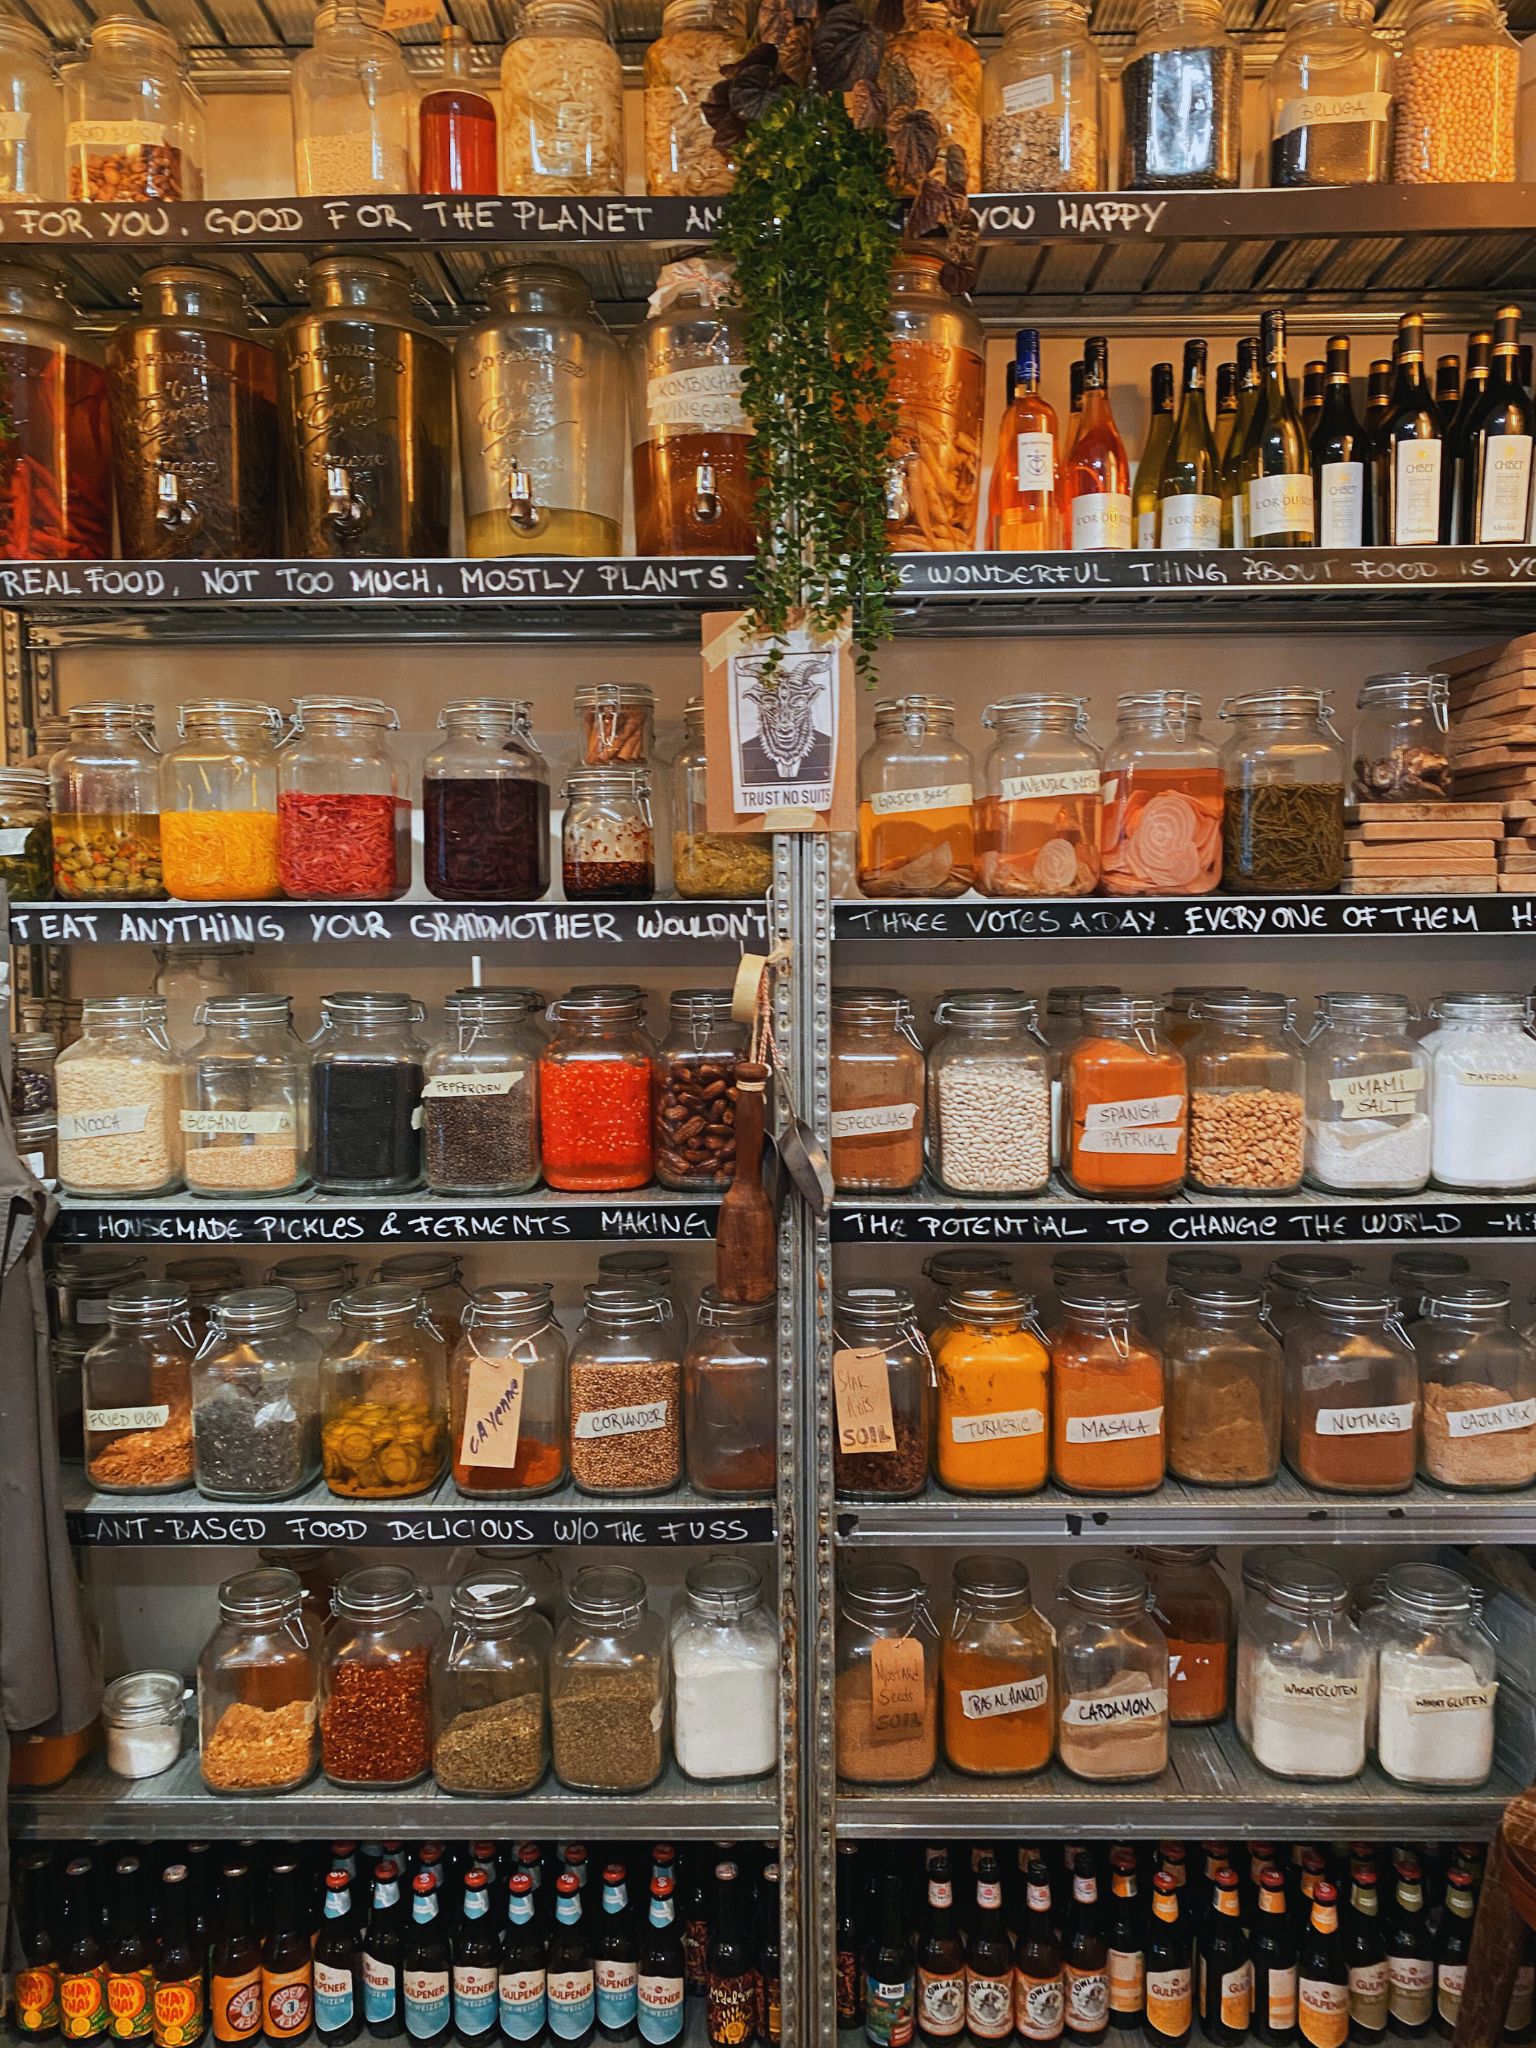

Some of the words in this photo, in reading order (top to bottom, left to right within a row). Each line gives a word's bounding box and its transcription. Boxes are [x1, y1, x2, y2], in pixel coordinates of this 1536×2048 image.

[15, 209, 93, 239] FOR
[205, 207, 303, 234] GOOD
[324, 202, 411, 235] FOR
[422, 201, 503, 231] THE
[512, 201, 654, 235] PLANET
[970, 204, 1035, 230] YOU
[1057, 199, 1168, 232] HAPPY
[659, 371, 738, 397] KOMBUCHA
[664, 401, 733, 419] VINEGAR
[1, 569, 82, 597] REAL
[201, 567, 259, 594] NOT
[276, 567, 333, 592] TOO
[350, 568, 442, 594] MUCH,
[461, 568, 584, 593] MOSTLY
[927, 562, 1111, 585] WONDERFUL
[1129, 562, 1228, 584] THING
[1243, 557, 1340, 581] ABOUT
[1351, 558, 1437, 579] FOOD
[1461, 558, 1490, 576] IS
[742, 792, 779, 807] TRUST
[782, 791, 799, 805] NO
[802, 789, 831, 804] SUITS
[41, 913, 98, 942] EAT
[310, 910, 392, 942] YOUR
[409, 912, 624, 942] GRANDMOTHER
[636, 907, 766, 940] WOULDN'T
[849, 909, 949, 932] THREE
[965, 909, 1061, 934] VOTES
[435, 1081, 501, 1094] PEPPERCORN
[1357, 1098, 1415, 1113] SALT
[98, 1215, 243, 1241] HOUSEMADE
[255, 1214, 364, 1239] PICKLES
[380, 1211, 401, 1237] &
[408, 1214, 572, 1237] FERMENTS
[601, 1211, 712, 1237] MAKING
[844, 1213, 907, 1239] THE
[918, 1215, 1088, 1237] POTENTIAL
[1107, 1217, 1149, 1234] TO
[1288, 1215, 1348, 1238] THE
[1362, 1213, 1461, 1235] WORLD
[89, 1411, 129, 1427] FRIED
[592, 1408, 665, 1432] CORIANDER
[1081, 1418, 1150, 1438] MASALA
[78, 1517, 267, 1541] LANT-BASED
[287, 1518, 367, 1540] FOOD
[388, 1518, 534, 1540] DELICIOUS
[604, 1520, 646, 1542] THE
[658, 1520, 749, 1541] FUSS
[968, 1694, 992, 1714] RAS
[1079, 1697, 1157, 1721] CARDAMOM
[156, 1991, 186, 2006] THAI
[502, 1983, 544, 1999] GULPENER
[550, 1984, 591, 2000] GULPENER
[156, 2007, 185, 2023] THAI
